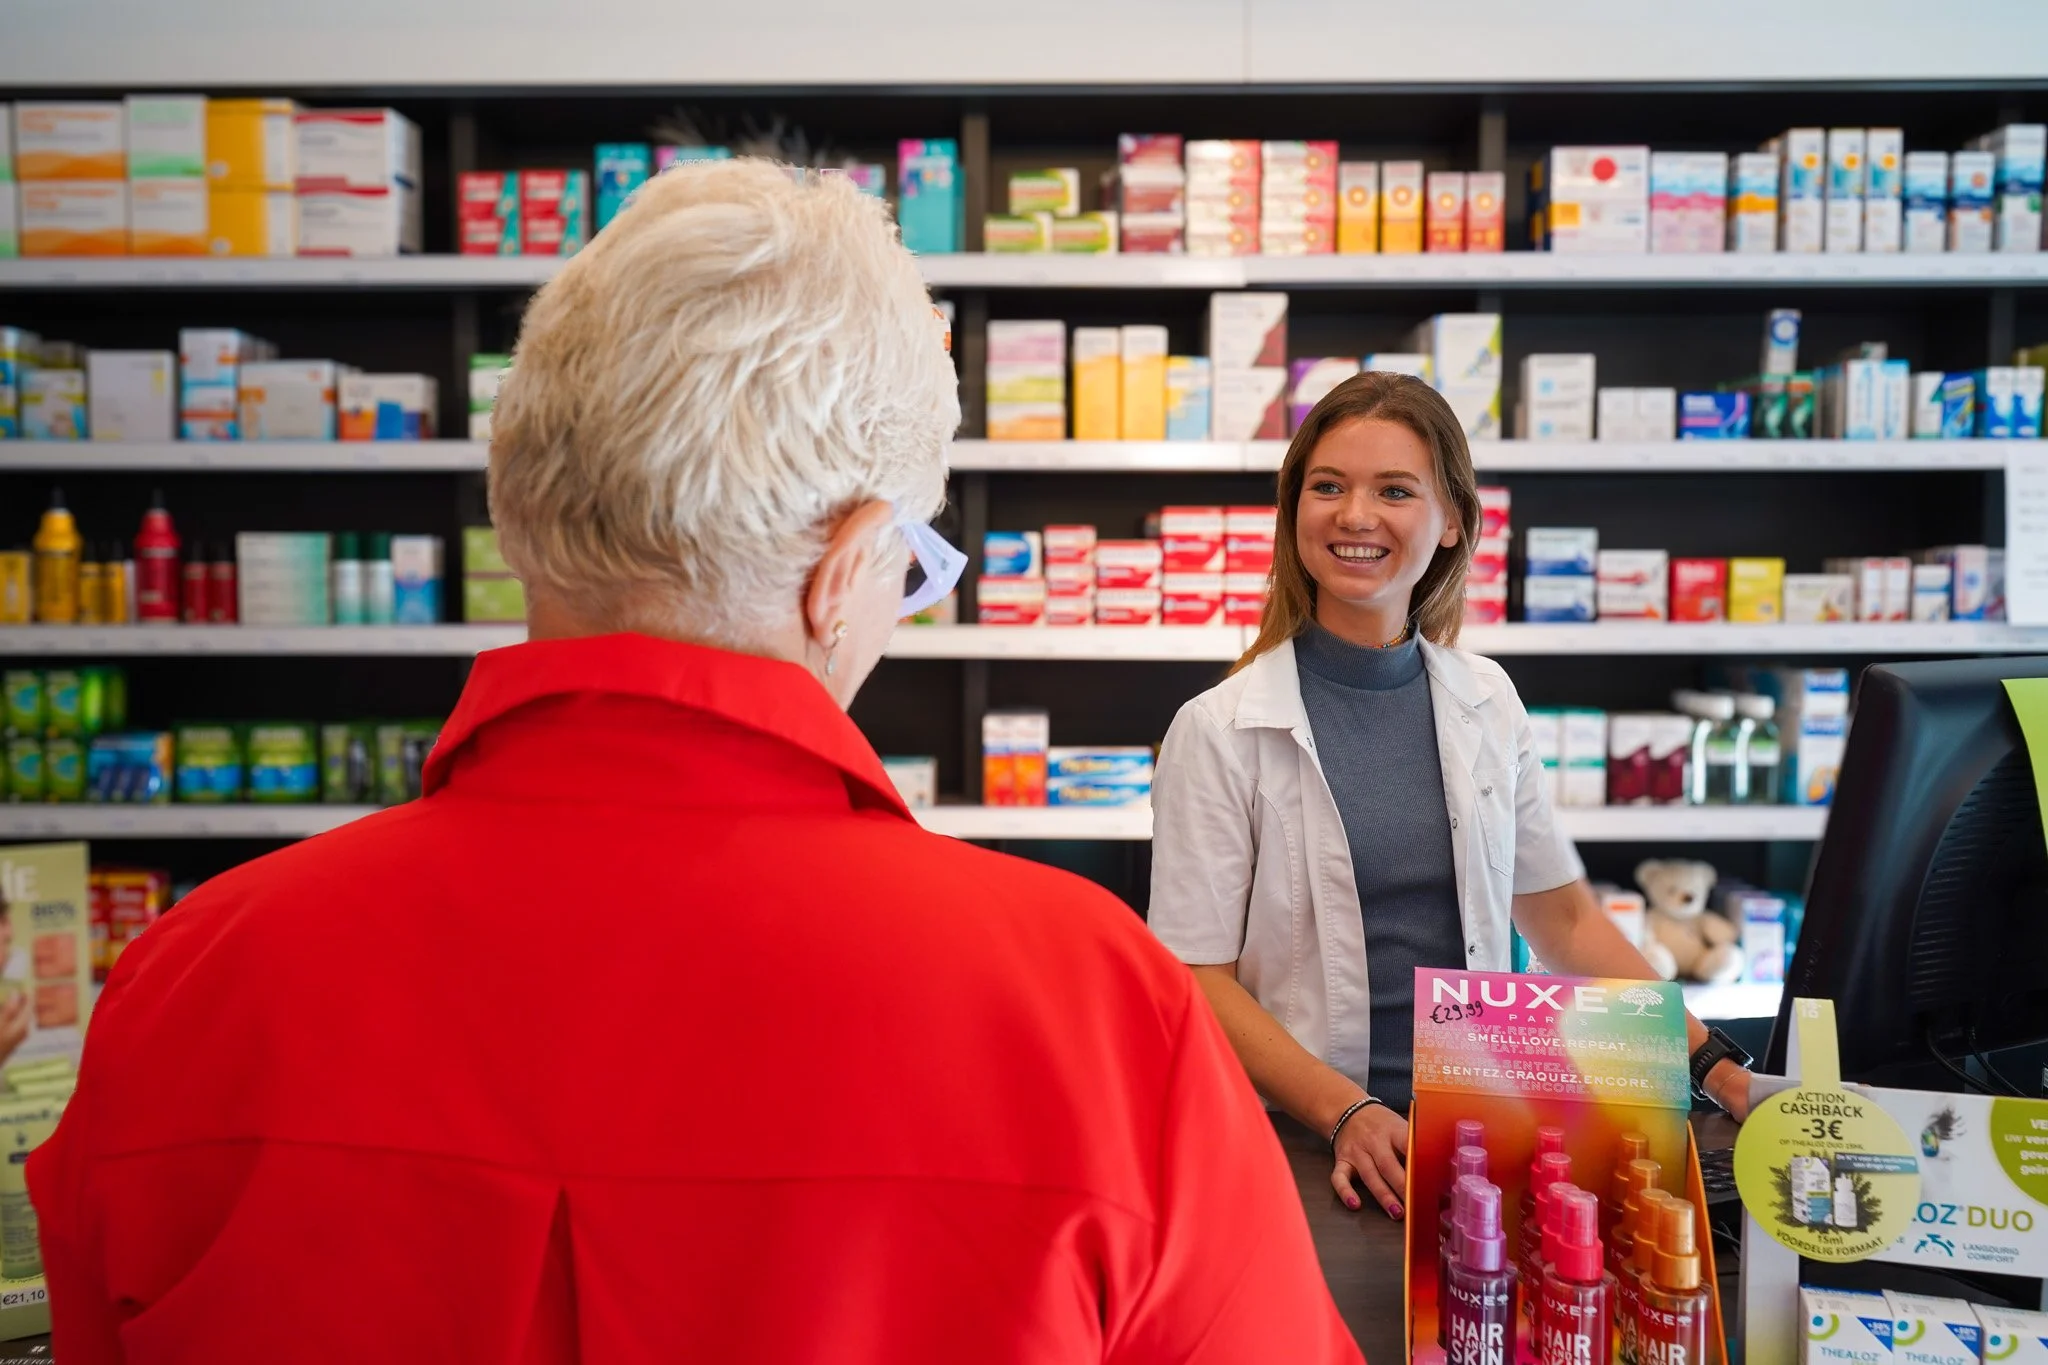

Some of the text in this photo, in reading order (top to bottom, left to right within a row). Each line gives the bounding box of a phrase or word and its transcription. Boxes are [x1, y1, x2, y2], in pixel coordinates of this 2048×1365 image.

[1433, 978, 1608, 1013] NUXE
[1509, 1013, 1588, 1026] PARIS
[1467, 1033, 1631, 1052] SMELL.LOVE.REPEAT.
[1442, 1065, 1653, 1089] SENTEZ.CRAQUEZ.ENCORE.
[1796, 1092, 1846, 1103] ACTION
[1780, 1102, 1864, 1118] CASHBACK
[1801, 1118, 1843, 1140] -3€
[1912, 1202, 2033, 1232] OZ DUO
[1777, 1229, 1884, 1256] VOORDELIG FORMAAT
[1967, 1253, 2015, 1264] COMFORT
[3, 1289, 45, 1305] €21,10
[1449, 1284, 1495, 1306] NUXE
[1452, 1313, 1504, 1347] HAIR
[1542, 1320, 1591, 1359] HAIR
[1451, 1339, 1504, 1365] SKIN
[1638, 1330, 1686, 1365] HAIR
[1820, 1346, 1882, 1361] THEALOZ
